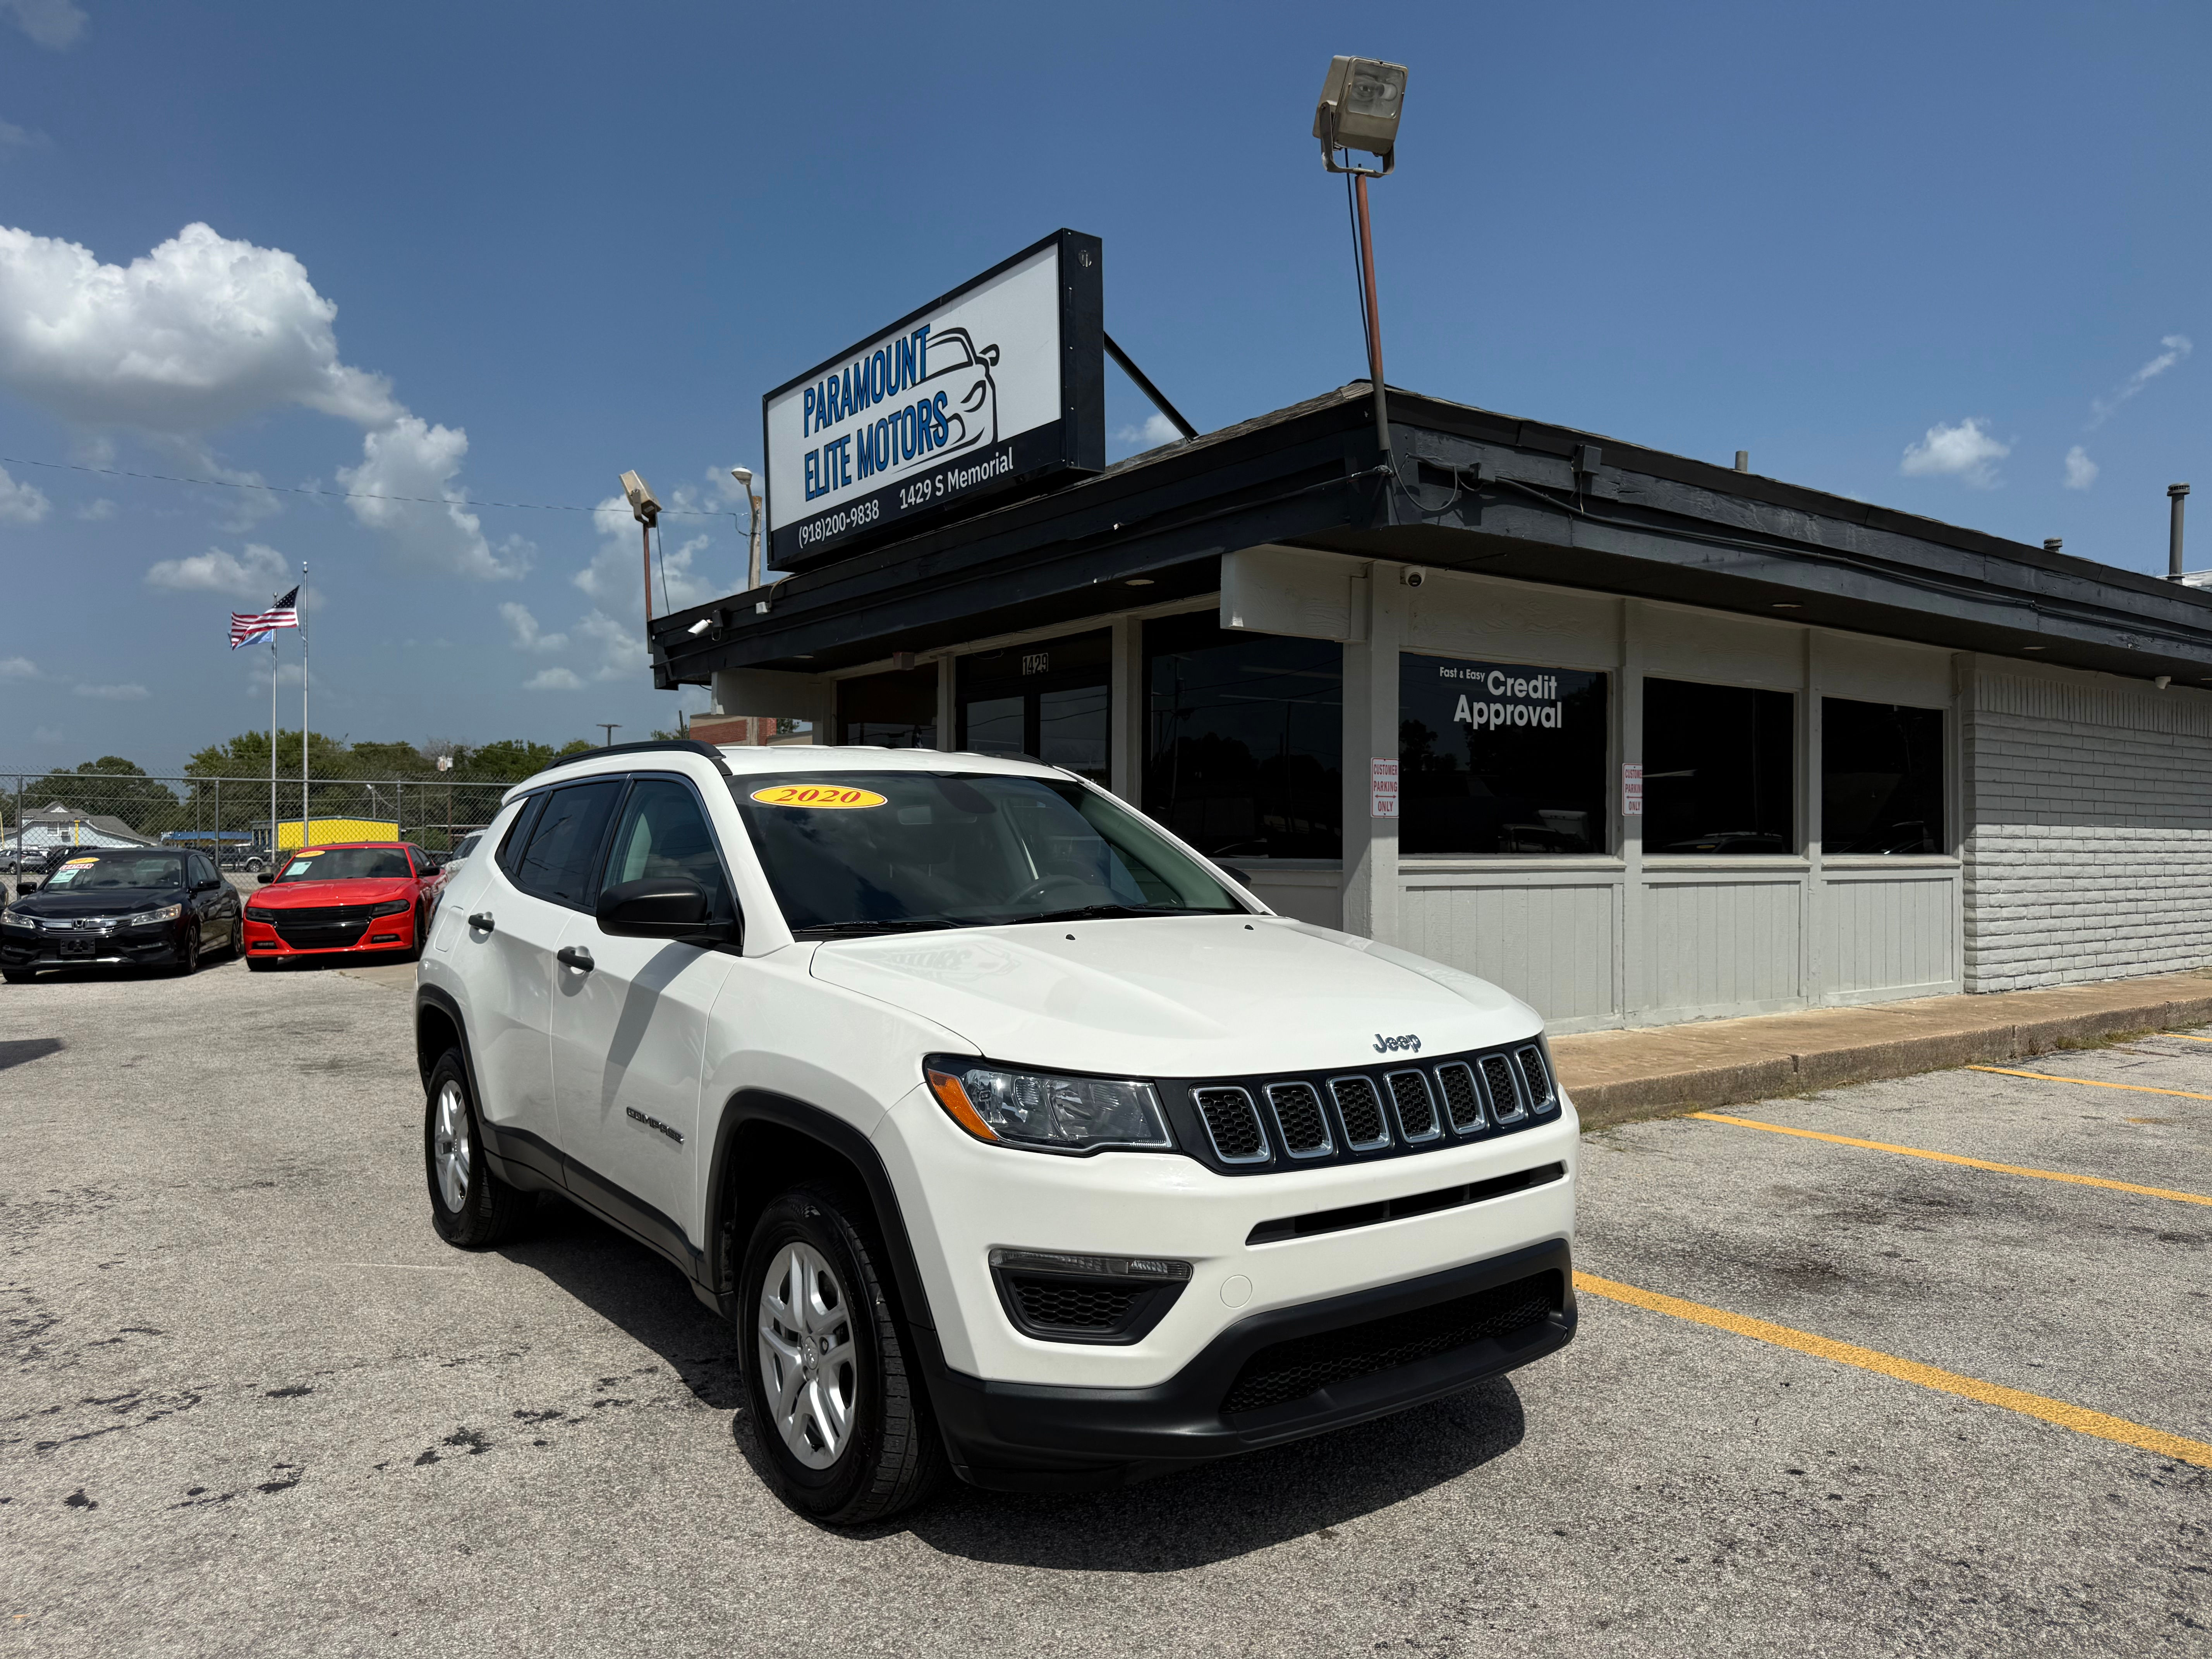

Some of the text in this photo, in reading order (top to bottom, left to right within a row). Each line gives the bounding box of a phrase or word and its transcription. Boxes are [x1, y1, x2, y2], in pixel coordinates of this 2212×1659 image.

[804, 323, 930, 438] PARAMOUNT
[805, 390, 949, 502] ELITE MOTORS
[900, 447, 1013, 509] 1429 S Memorial
[799, 499, 879, 548] (918)200-9838
[1024, 653, 1048, 674] 1429
[1440, 666, 1557, 699] Fast & Easy Credit
[1453, 694, 1562, 730] Approval
[1374, 764, 1397, 775] CUSTOMER
[1625, 769, 1642, 779] CUSTOME
[774, 789, 861, 803] 2020
[1374, 781, 1397, 792] PARKING
[1625, 783, 1642, 793] PARKIN
[1378, 800, 1393, 812] ONLY
[1628, 801, 1641, 811] ONLY
[1372, 1034, 1422, 1054] Jeep
[627, 1106, 685, 1145] COMPASS
